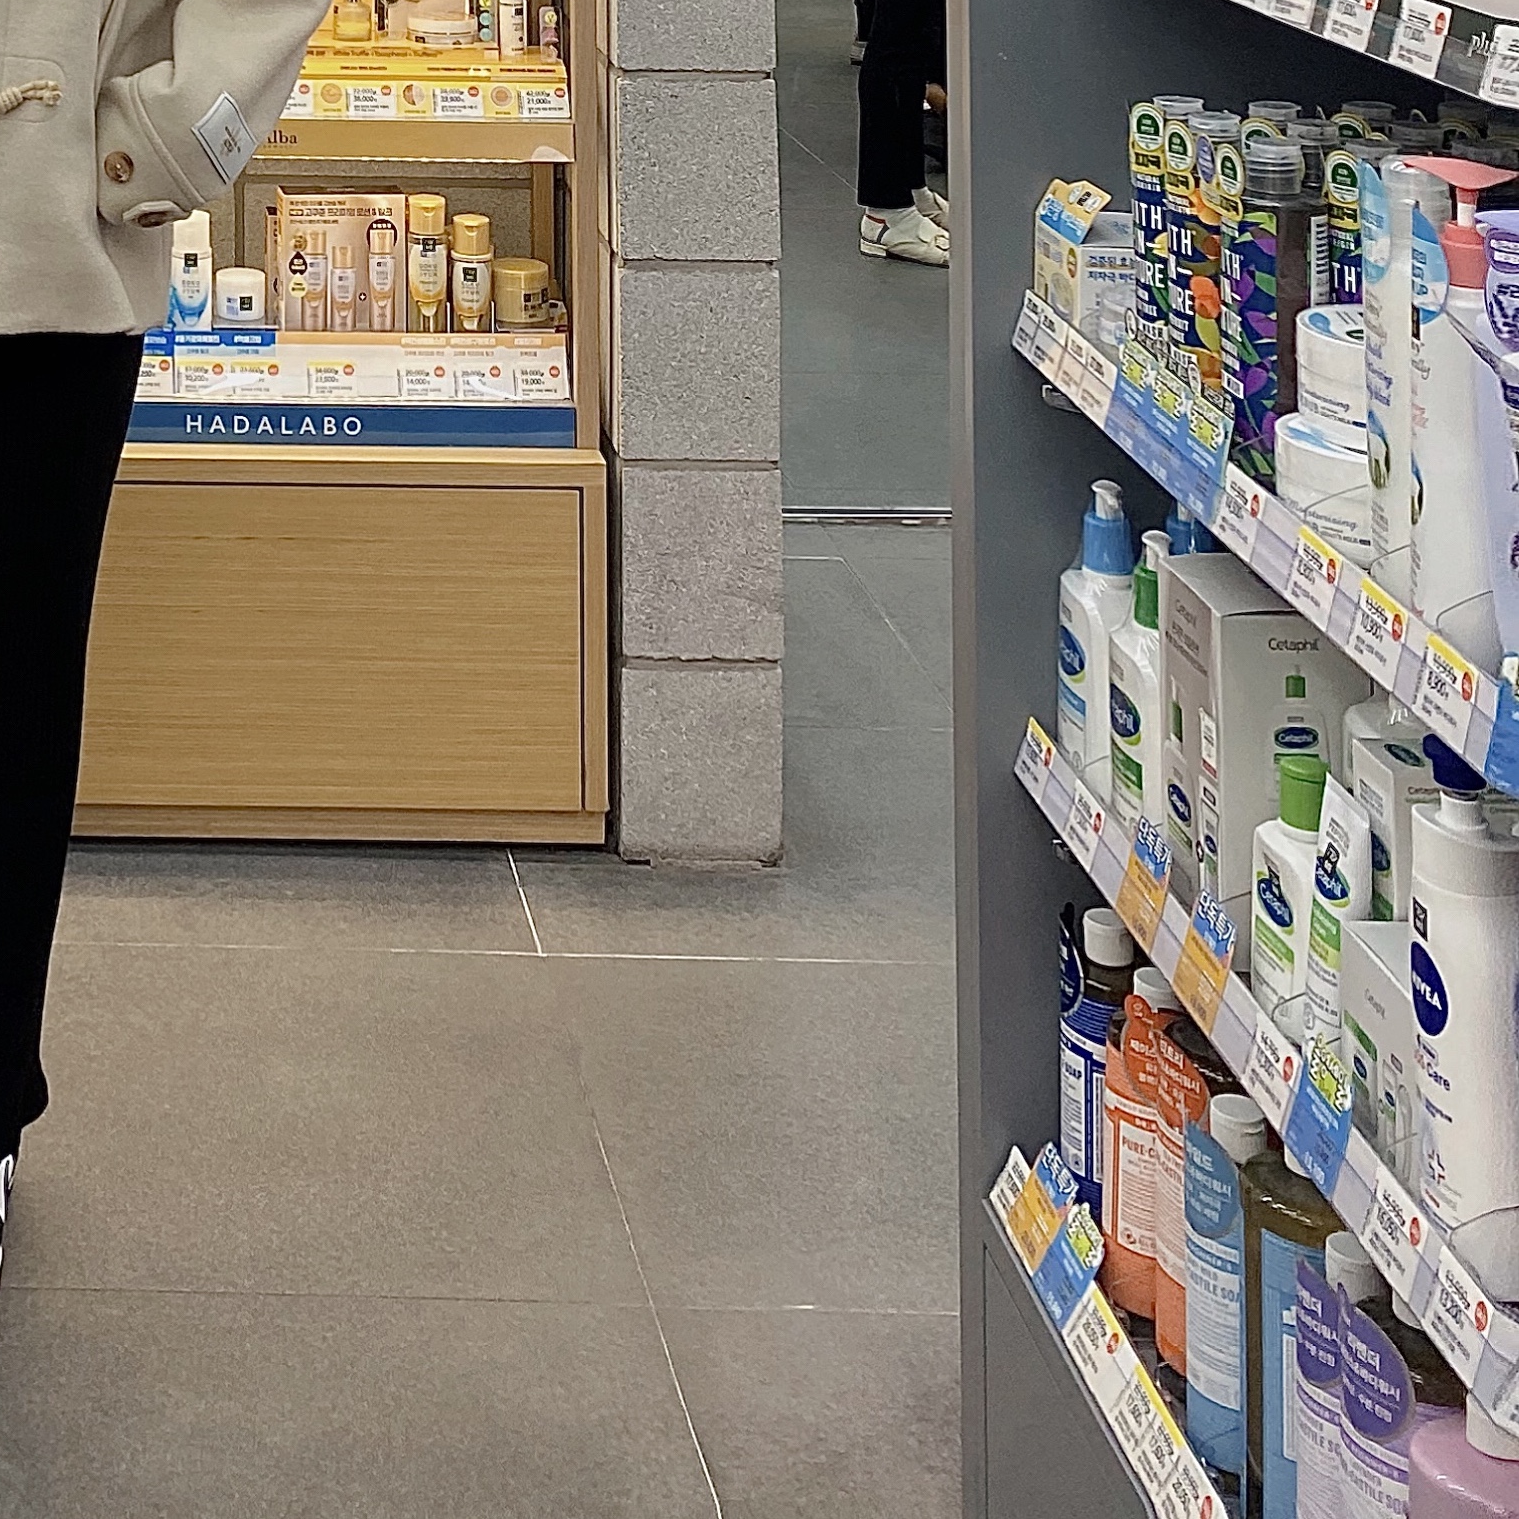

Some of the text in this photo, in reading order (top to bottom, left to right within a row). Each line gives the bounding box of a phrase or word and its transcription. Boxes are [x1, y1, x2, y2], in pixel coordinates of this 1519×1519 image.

[185, 415, 363, 436] HADALABO
[1267, 637, 1320, 654] Cetaphil
[1426, 1061, 1451, 1092] Care
